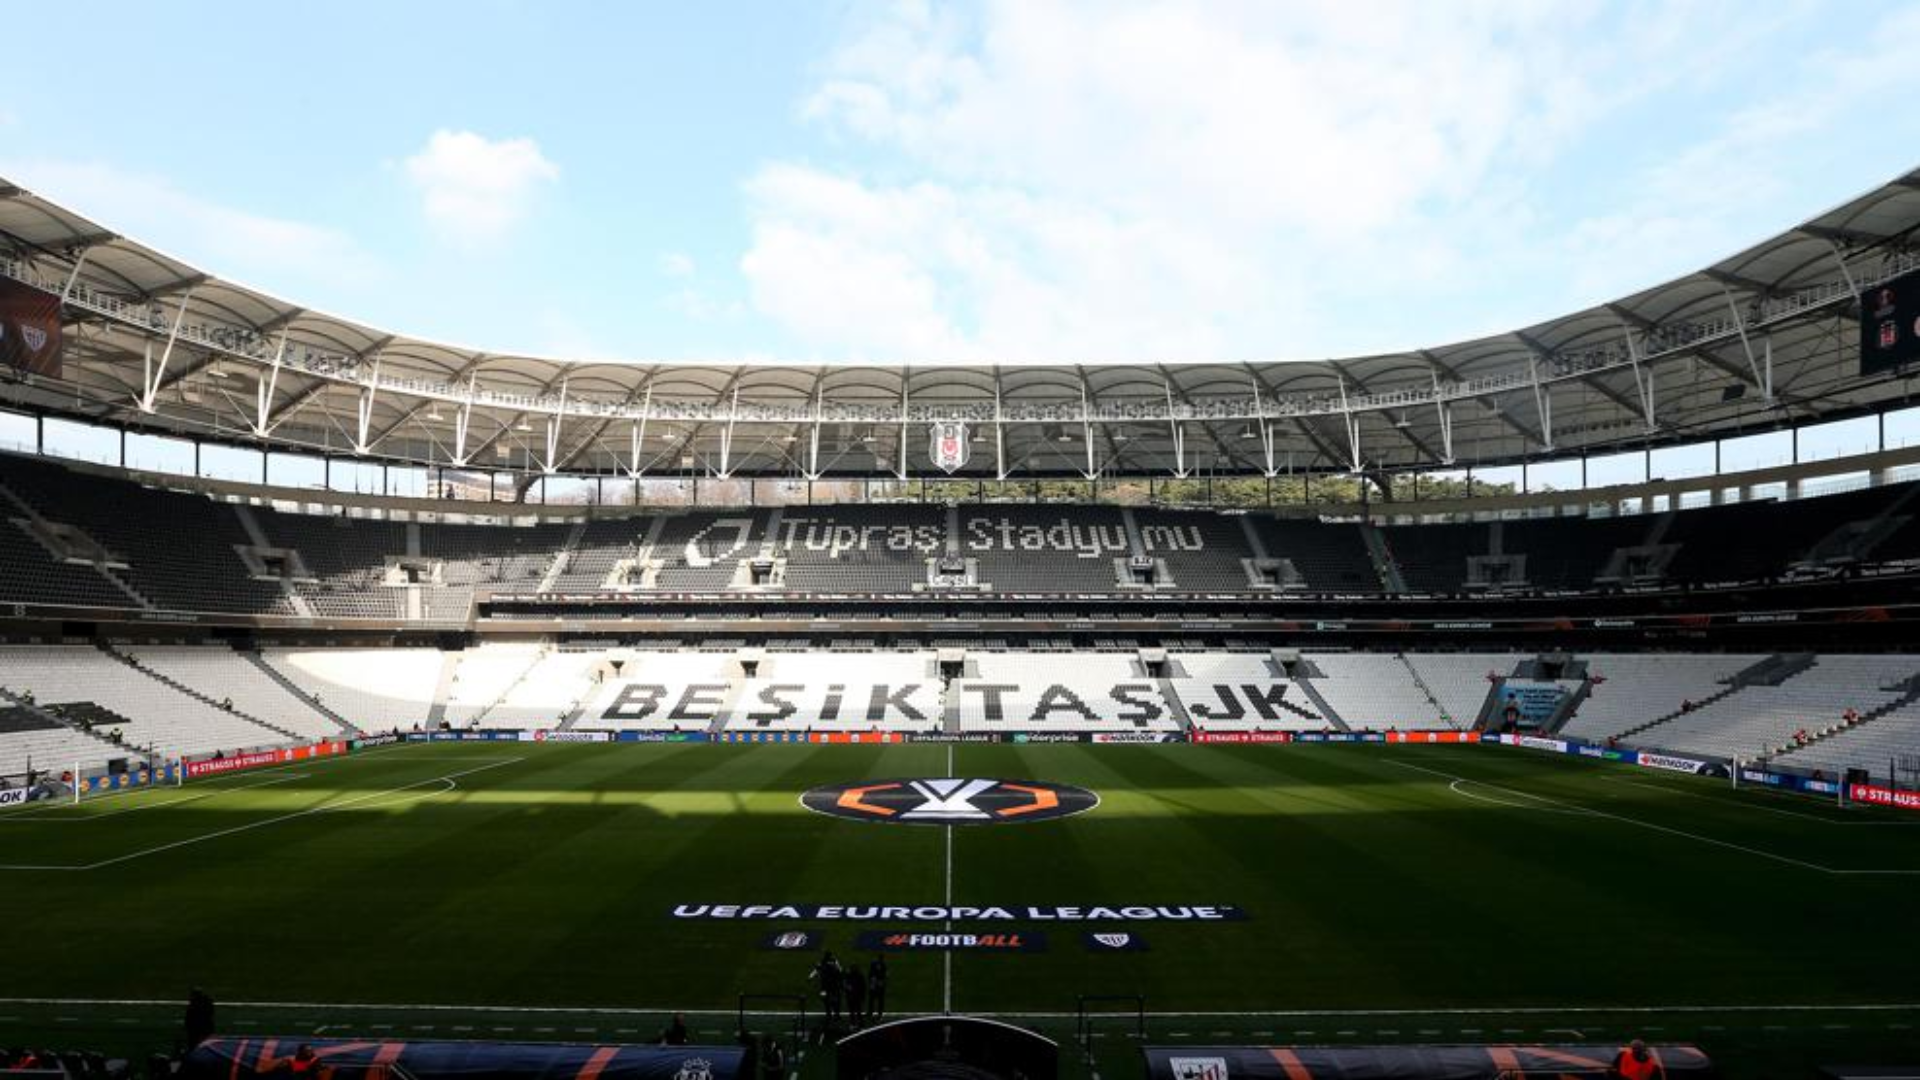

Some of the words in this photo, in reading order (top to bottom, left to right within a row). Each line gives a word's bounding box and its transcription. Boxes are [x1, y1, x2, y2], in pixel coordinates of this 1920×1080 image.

[780, 518, 939, 558] Tüpraş
[968, 518, 1204, 558] Stadyumu
[1190, 684, 1322, 719] JK
[1868, 787, 1920, 807] STRAUS
[673, 904, 801, 919] UEFA
[815, 906, 1016, 920] EUROPA
[884, 933, 1023, 947] #FOOTBALL
